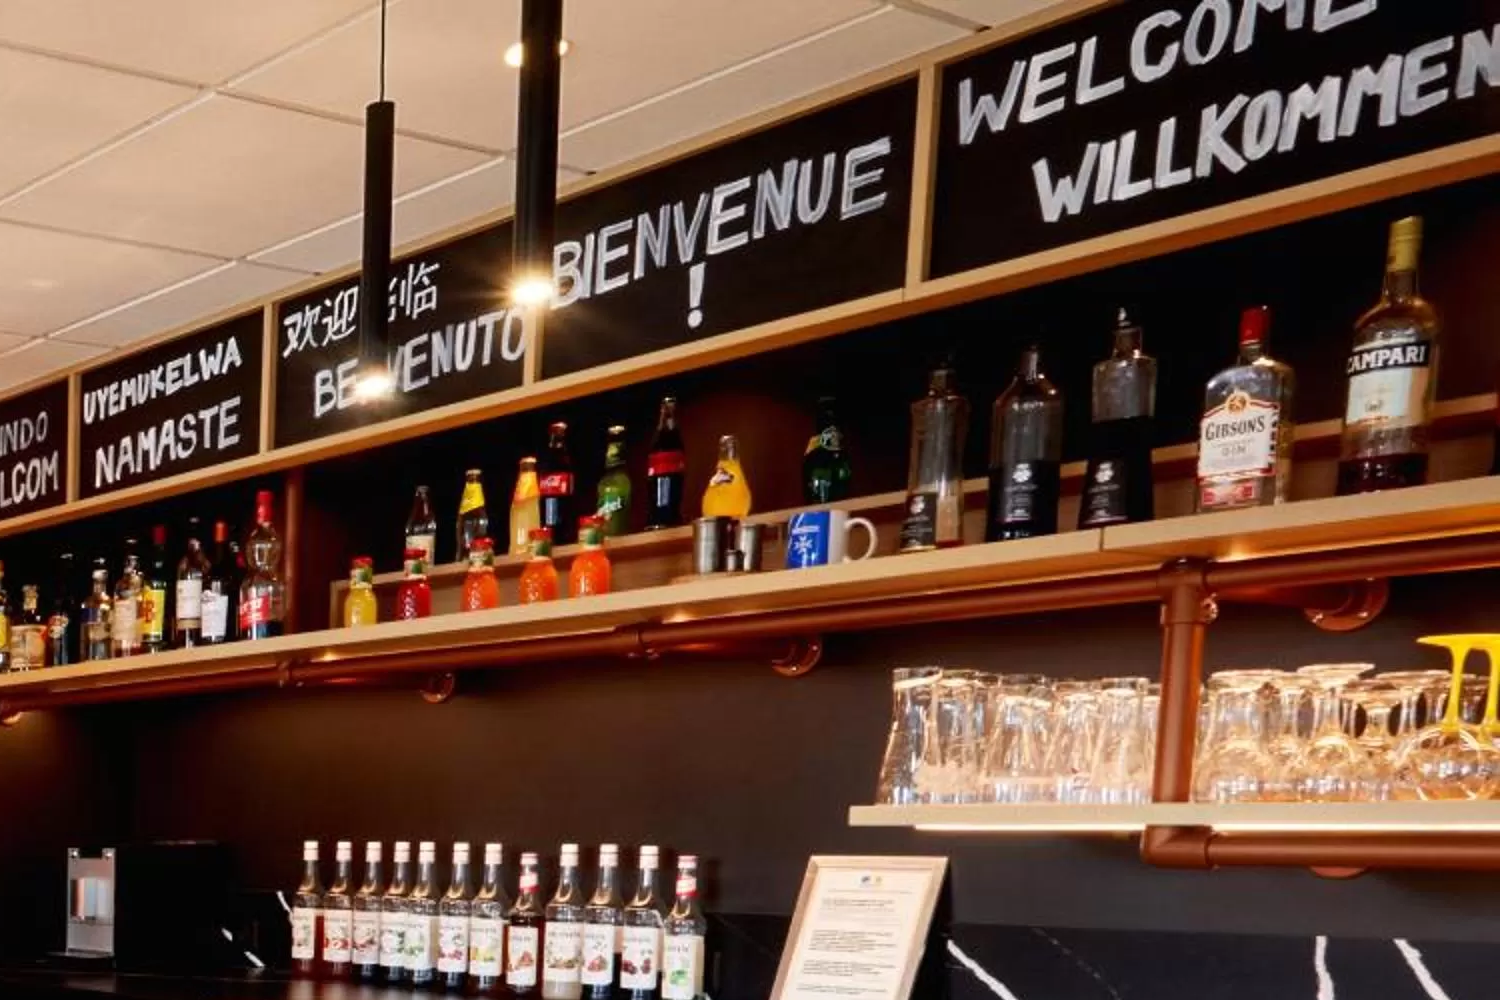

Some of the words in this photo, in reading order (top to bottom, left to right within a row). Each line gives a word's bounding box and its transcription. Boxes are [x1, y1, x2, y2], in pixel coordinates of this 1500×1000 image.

[1031, 23, 1500, 223] WILLKOMMEN
[550, 136, 891, 311] BIENVENUE
[687, 261, 706, 329] !
[83, 335, 243, 425] UYEMUKELWA
[314, 308, 525, 418] BEVENUTO
[1347, 345, 1426, 374] CAMPARI
[94, 395, 241, 489] NAMASTE
